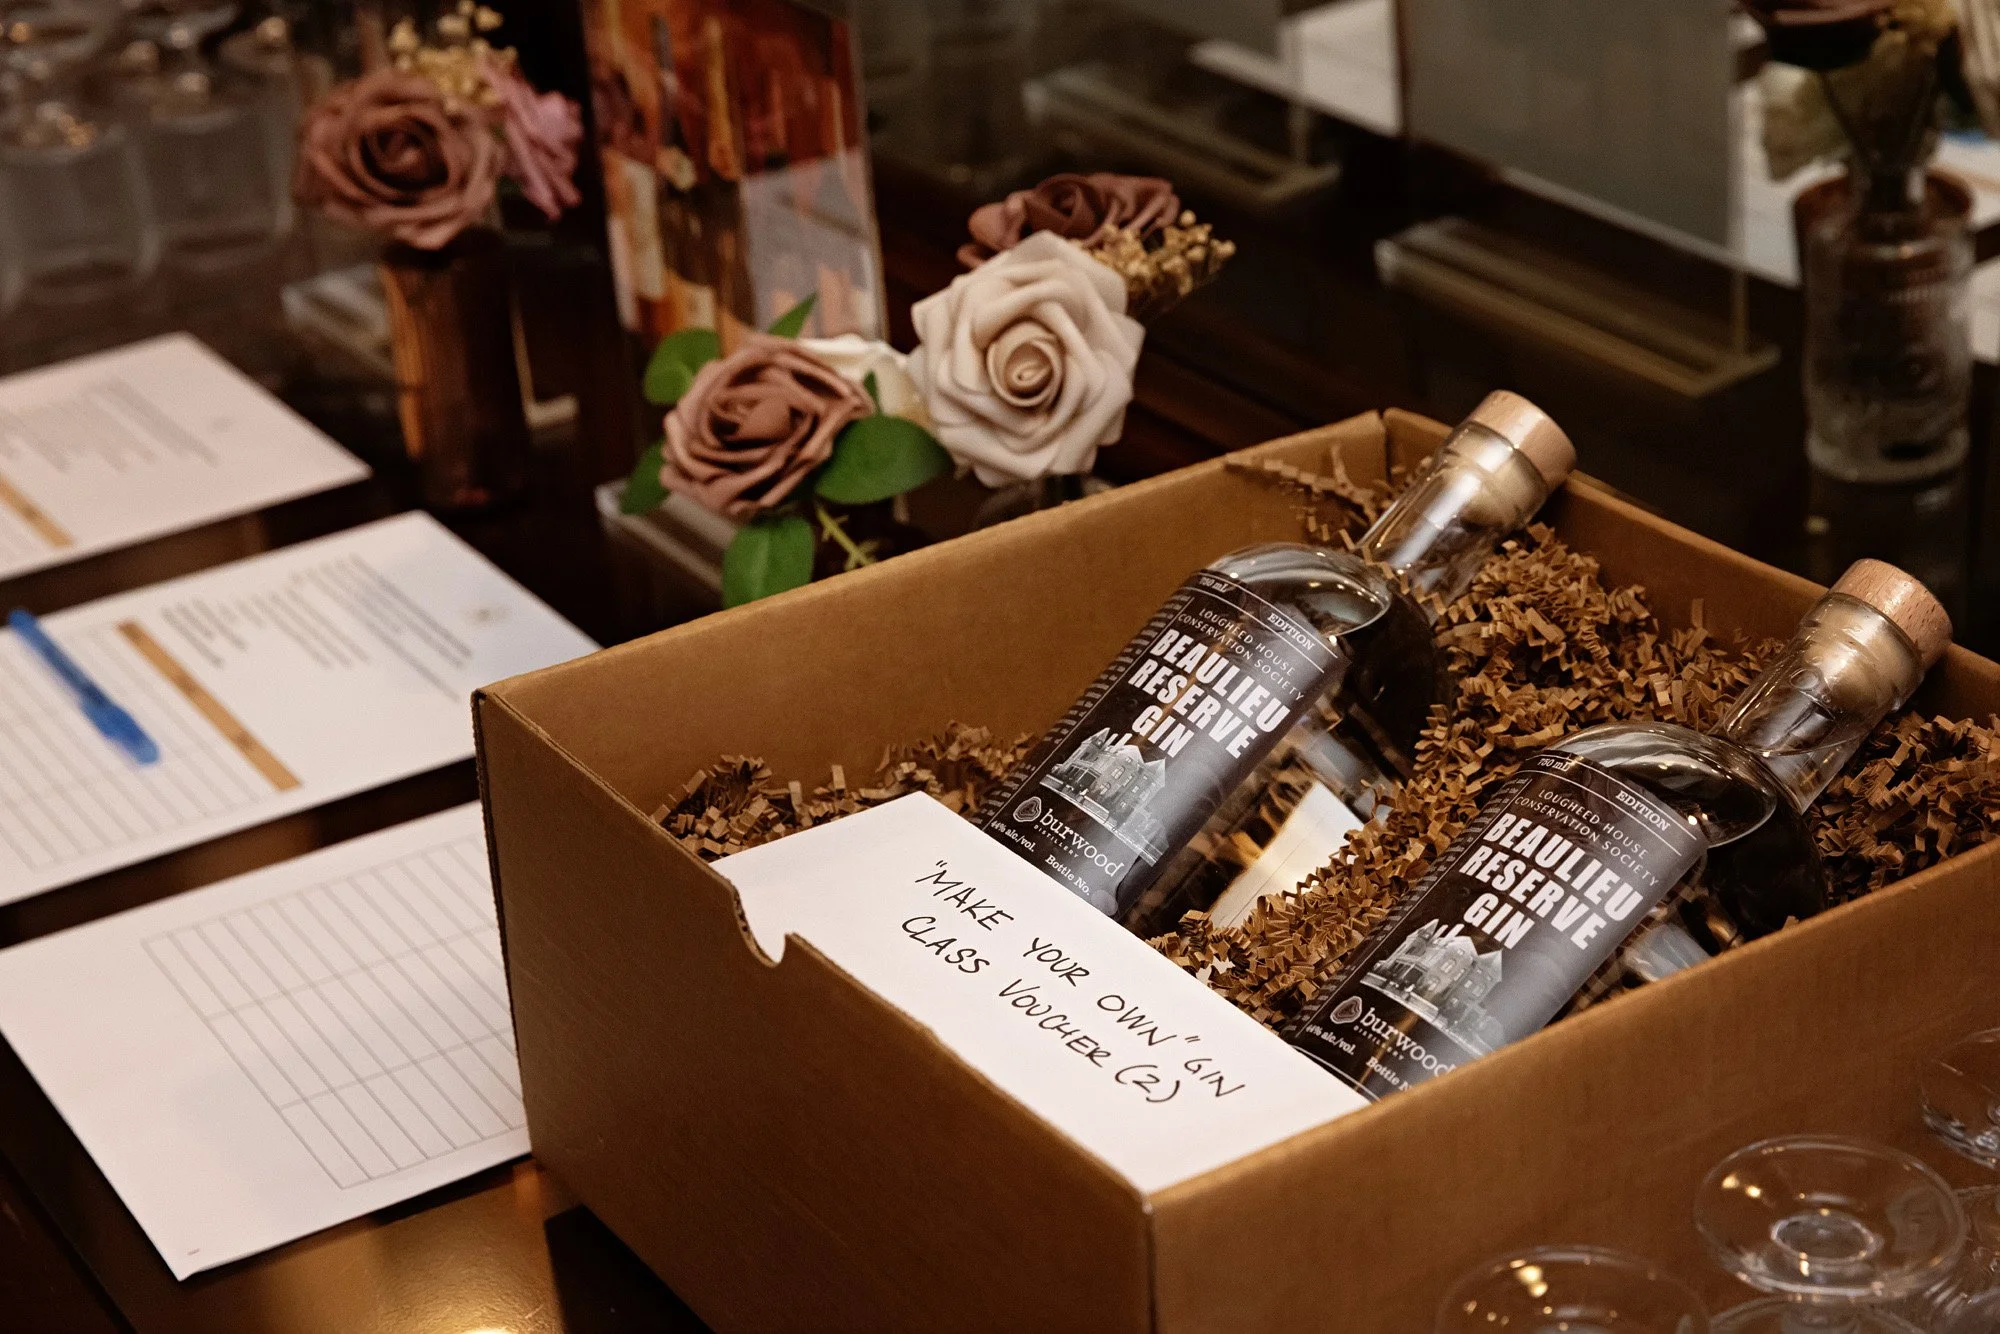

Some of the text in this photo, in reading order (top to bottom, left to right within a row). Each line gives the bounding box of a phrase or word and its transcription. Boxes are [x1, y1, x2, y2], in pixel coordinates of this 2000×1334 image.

[1211, 580, 1230, 593] mL
[1178, 613, 1305, 701] CONSERVATION SOCIETY
[1199, 608, 1254, 644] LOUGHEED
[1255, 642, 1296, 677] HOUSE
[1267, 612, 1316, 651] EDITION
[1127, 658, 1259, 759] RESERVE
[1149, 628, 1291, 734] BEAULIEU
[1131, 704, 1195, 759] GIN
[1537, 758, 1571, 772] 750 mL
[1004, 826, 1036, 852] alc./vol.
[1033, 824, 1079, 858] DISTILLERY
[1040, 808, 1125, 877] burwood
[1514, 796, 1659, 887] CONSERVATION SOCIETY
[1538, 789, 1600, 825] LOUGHEED
[1603, 823, 1649, 859] HOUSE
[1615, 790, 1671, 832] EDITION
[1045, 854, 1091, 896] Bottle No.
[1458, 844, 1606, 950] RESERVE
[1482, 812, 1643, 922] BEAULIEU
[1462, 892, 1536, 950] GIN
[901, 915, 1181, 1103] CLASS VOUCHER (2)
[915, 859, 1246, 1099] "MAKE YOUR OWN" GIN
[1366, 1056, 1400, 1086] Bottle
